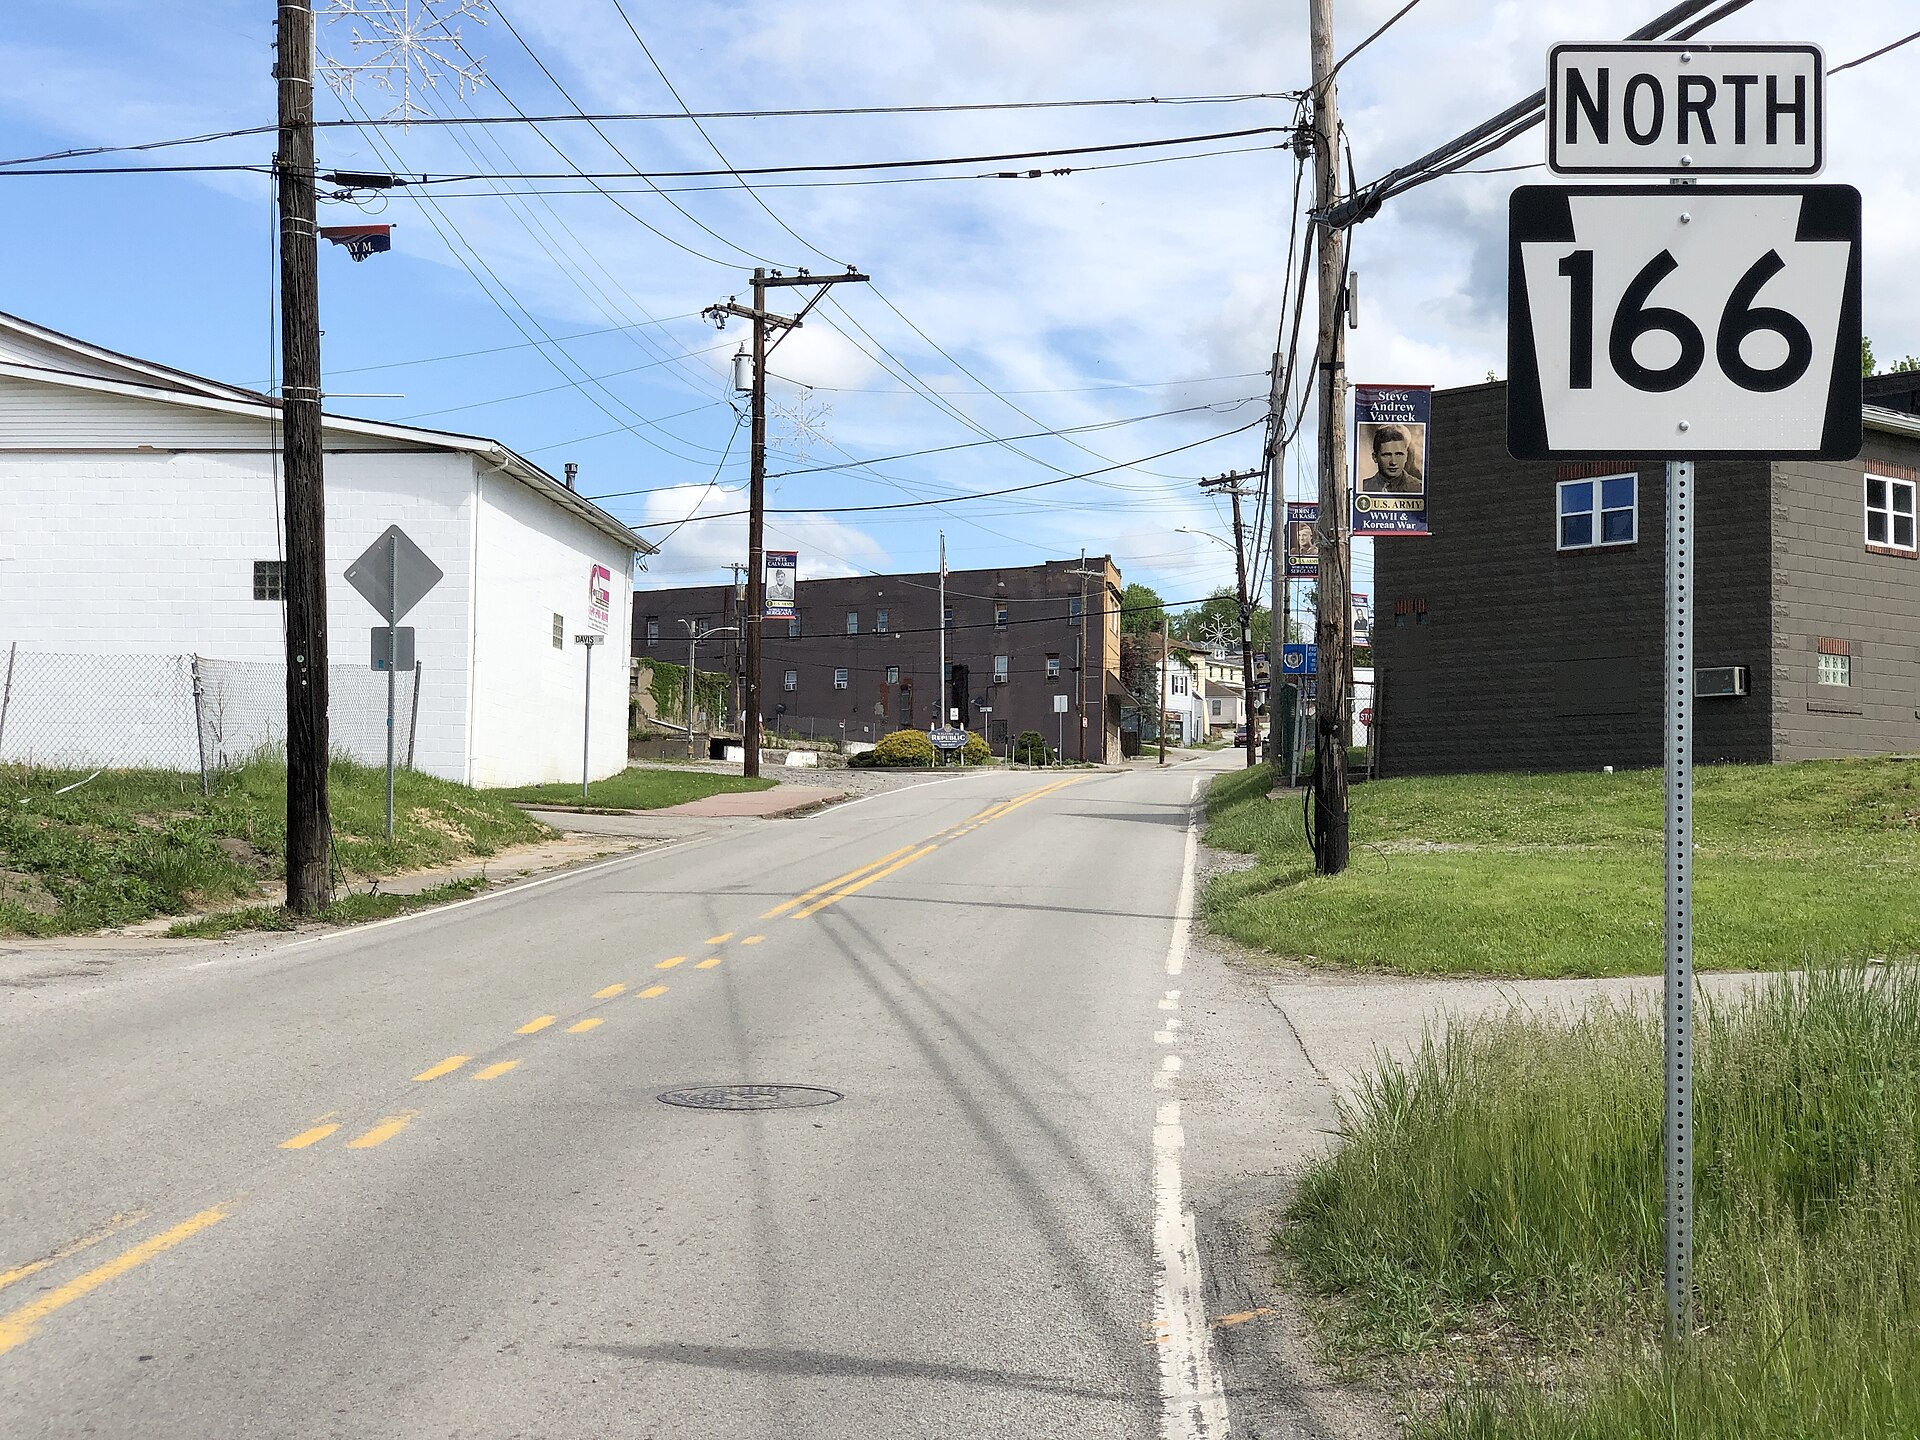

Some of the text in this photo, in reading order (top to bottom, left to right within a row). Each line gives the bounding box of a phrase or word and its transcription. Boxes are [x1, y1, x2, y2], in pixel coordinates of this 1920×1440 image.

[1565, 67, 1806, 146] NORTH
[362, 241, 375, 252] M.
[1558, 248, 1813, 393] 166
[1378, 391, 1409, 402] Steve
[1370, 402, 1416, 412] Andrew
[1370, 411, 1416, 422] Vavreck
[1373, 500, 1422, 509] U.S. ARMY
[1370, 512, 1409, 521] WWII &
[1363, 520, 1417, 530] Korean War
[575, 635, 595, 644] DAVIS
